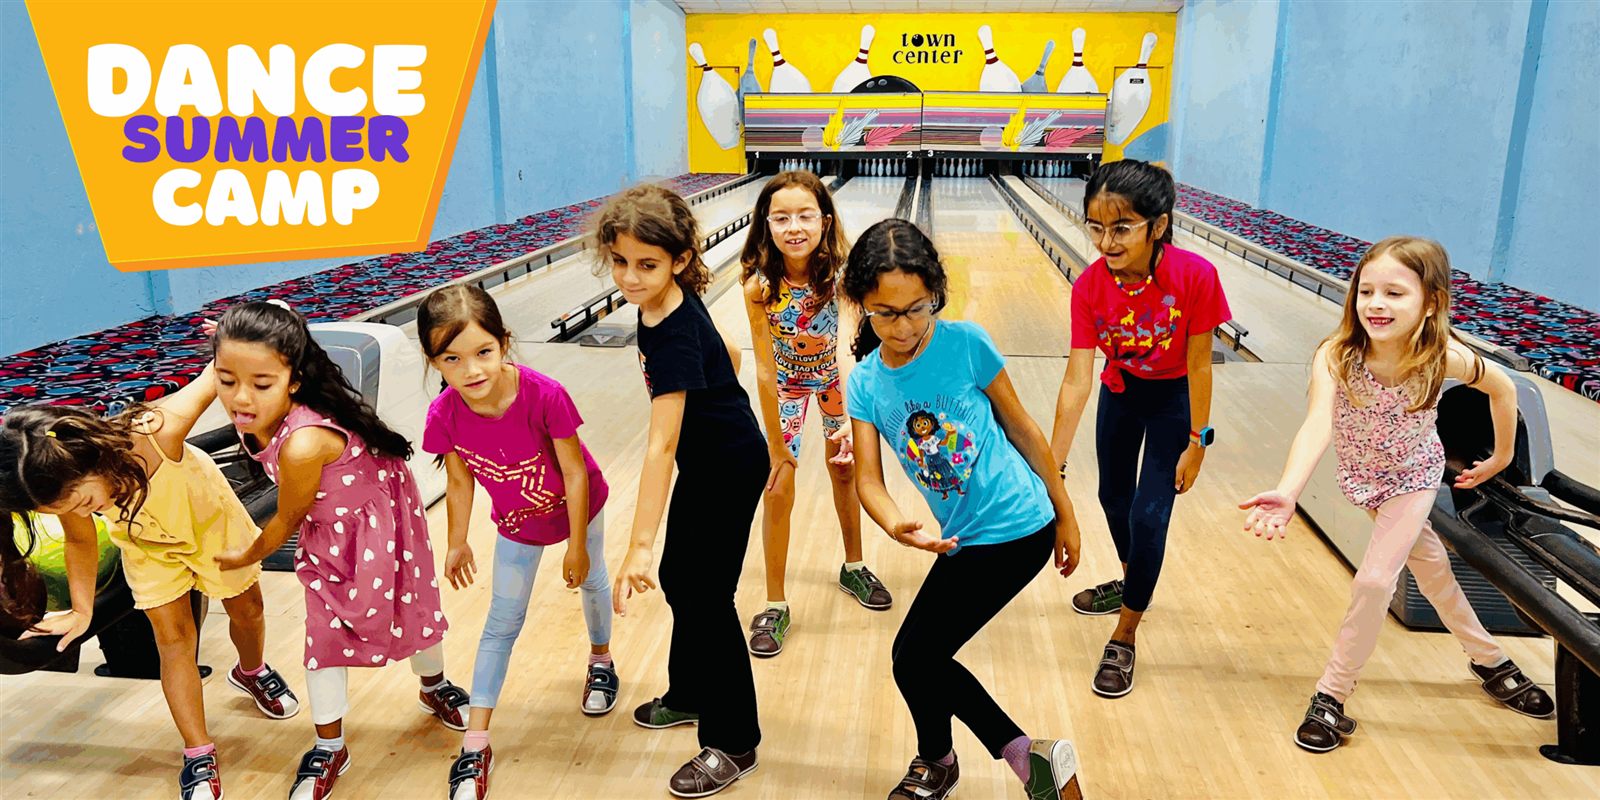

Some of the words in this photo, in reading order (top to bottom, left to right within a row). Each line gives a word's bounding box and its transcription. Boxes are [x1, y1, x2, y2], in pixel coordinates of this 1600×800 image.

[901, 33, 955, 47] town
[892, 50, 963, 64] center
[906, 150, 913, 158] 2
[775, 354, 792, 369] LOVE
[923, 401, 931, 409] a
